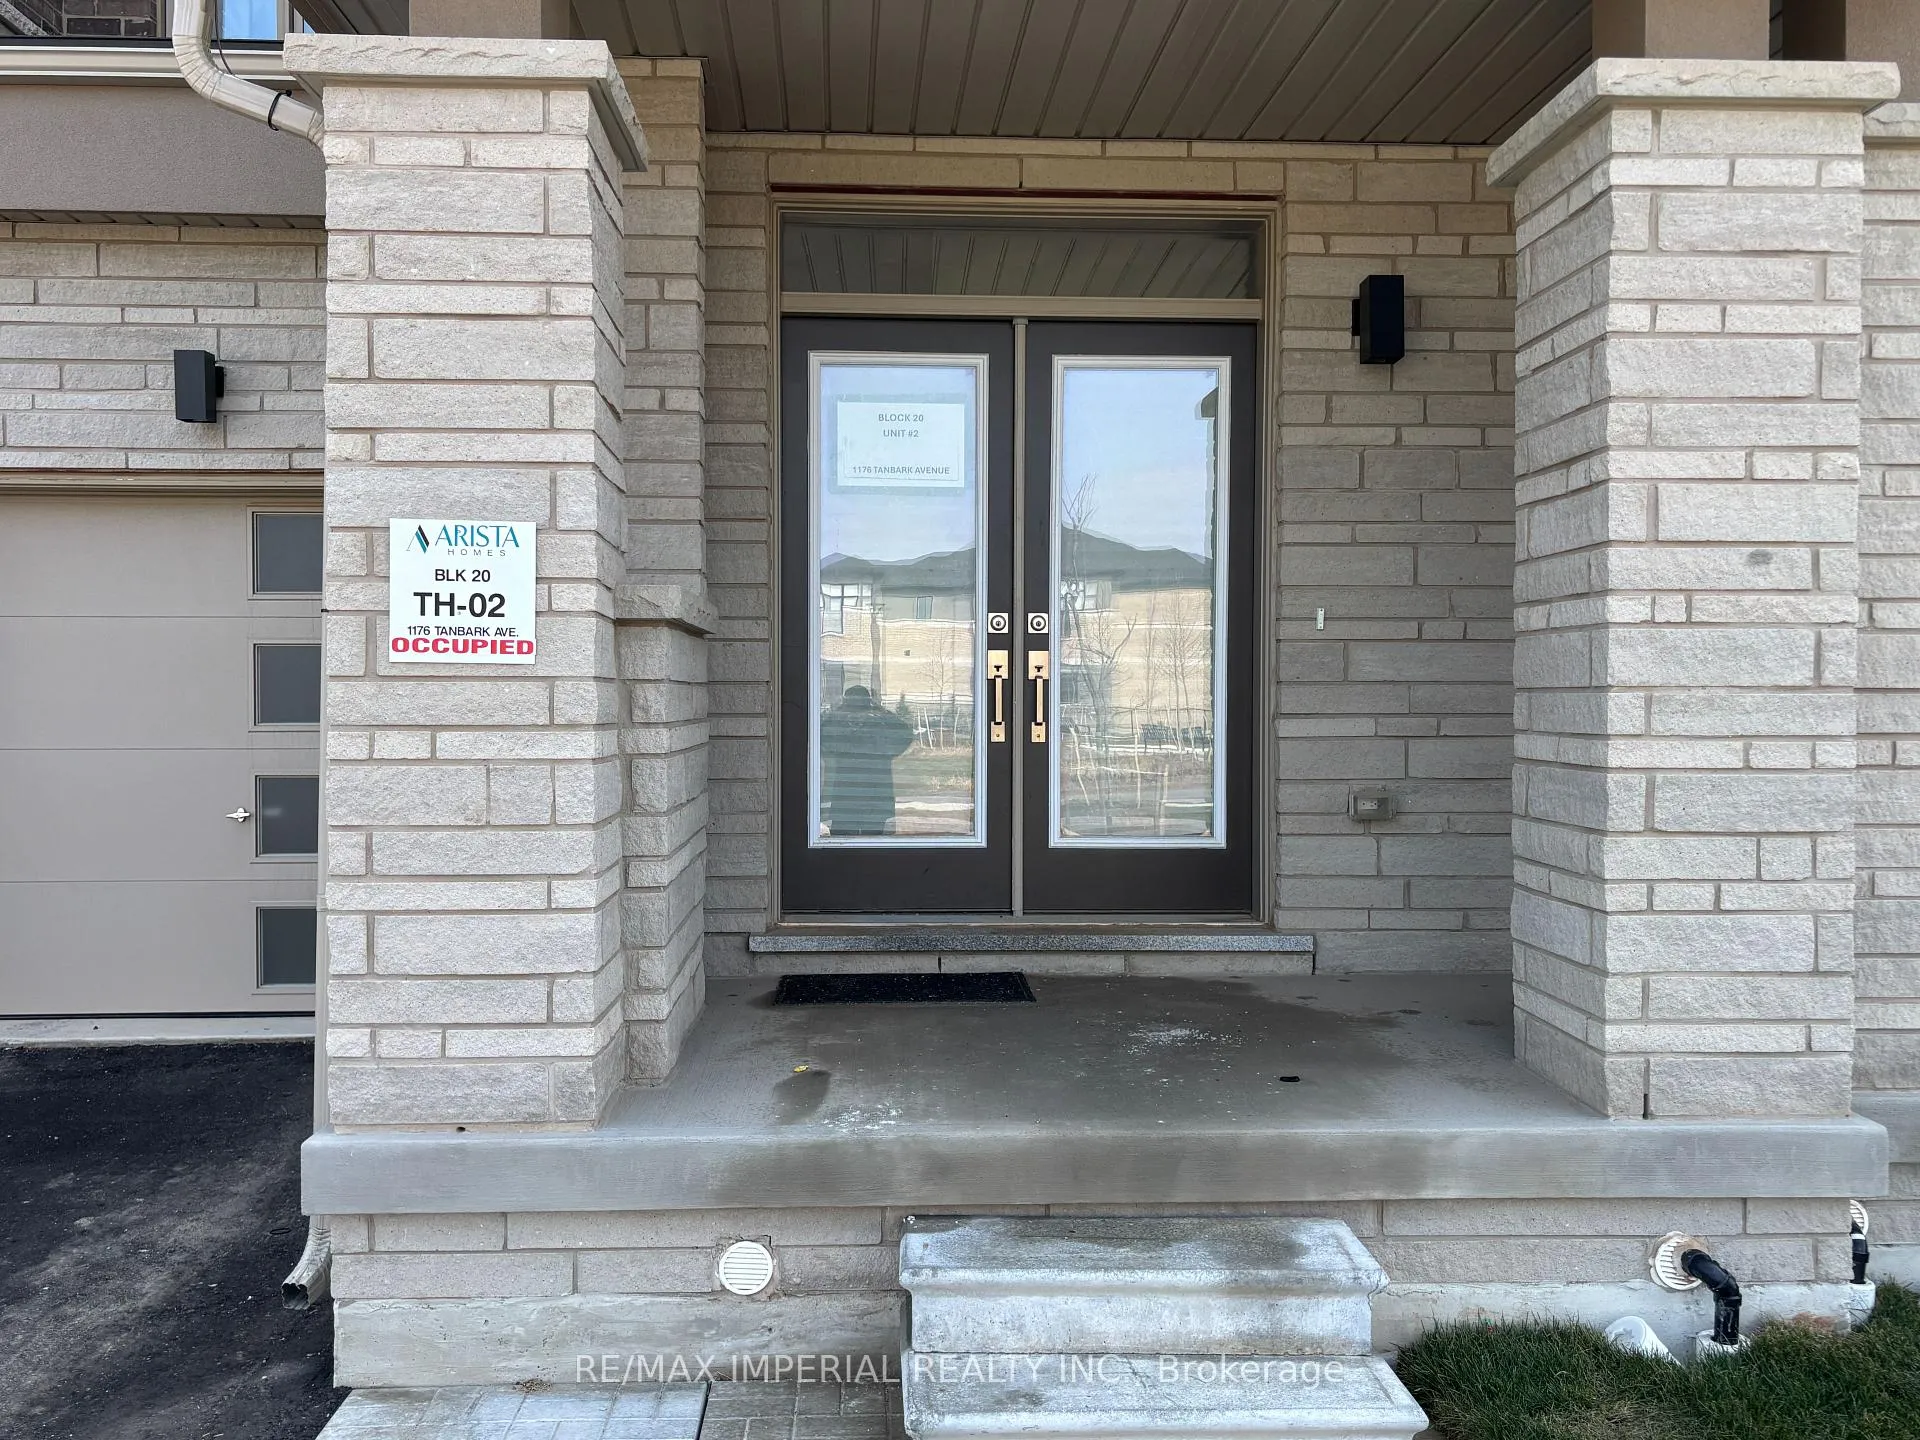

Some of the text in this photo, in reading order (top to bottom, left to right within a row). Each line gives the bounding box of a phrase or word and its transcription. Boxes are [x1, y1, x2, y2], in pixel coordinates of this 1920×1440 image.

[878, 413, 924, 422] BLOCK 20
[883, 429, 919, 438] UNIT #2
[852, 466, 950, 475] 1176 TANBARK AVENUE
[435, 524, 520, 548] ARISTA
[447, 548, 506, 557] HOMES
[435, 569, 491, 583] BLK 20
[413, 591, 506, 618] TH-02
[407, 625, 519, 638] 1176 TANBARK AVE.
[391, 637, 534, 655] OCCUPIED
